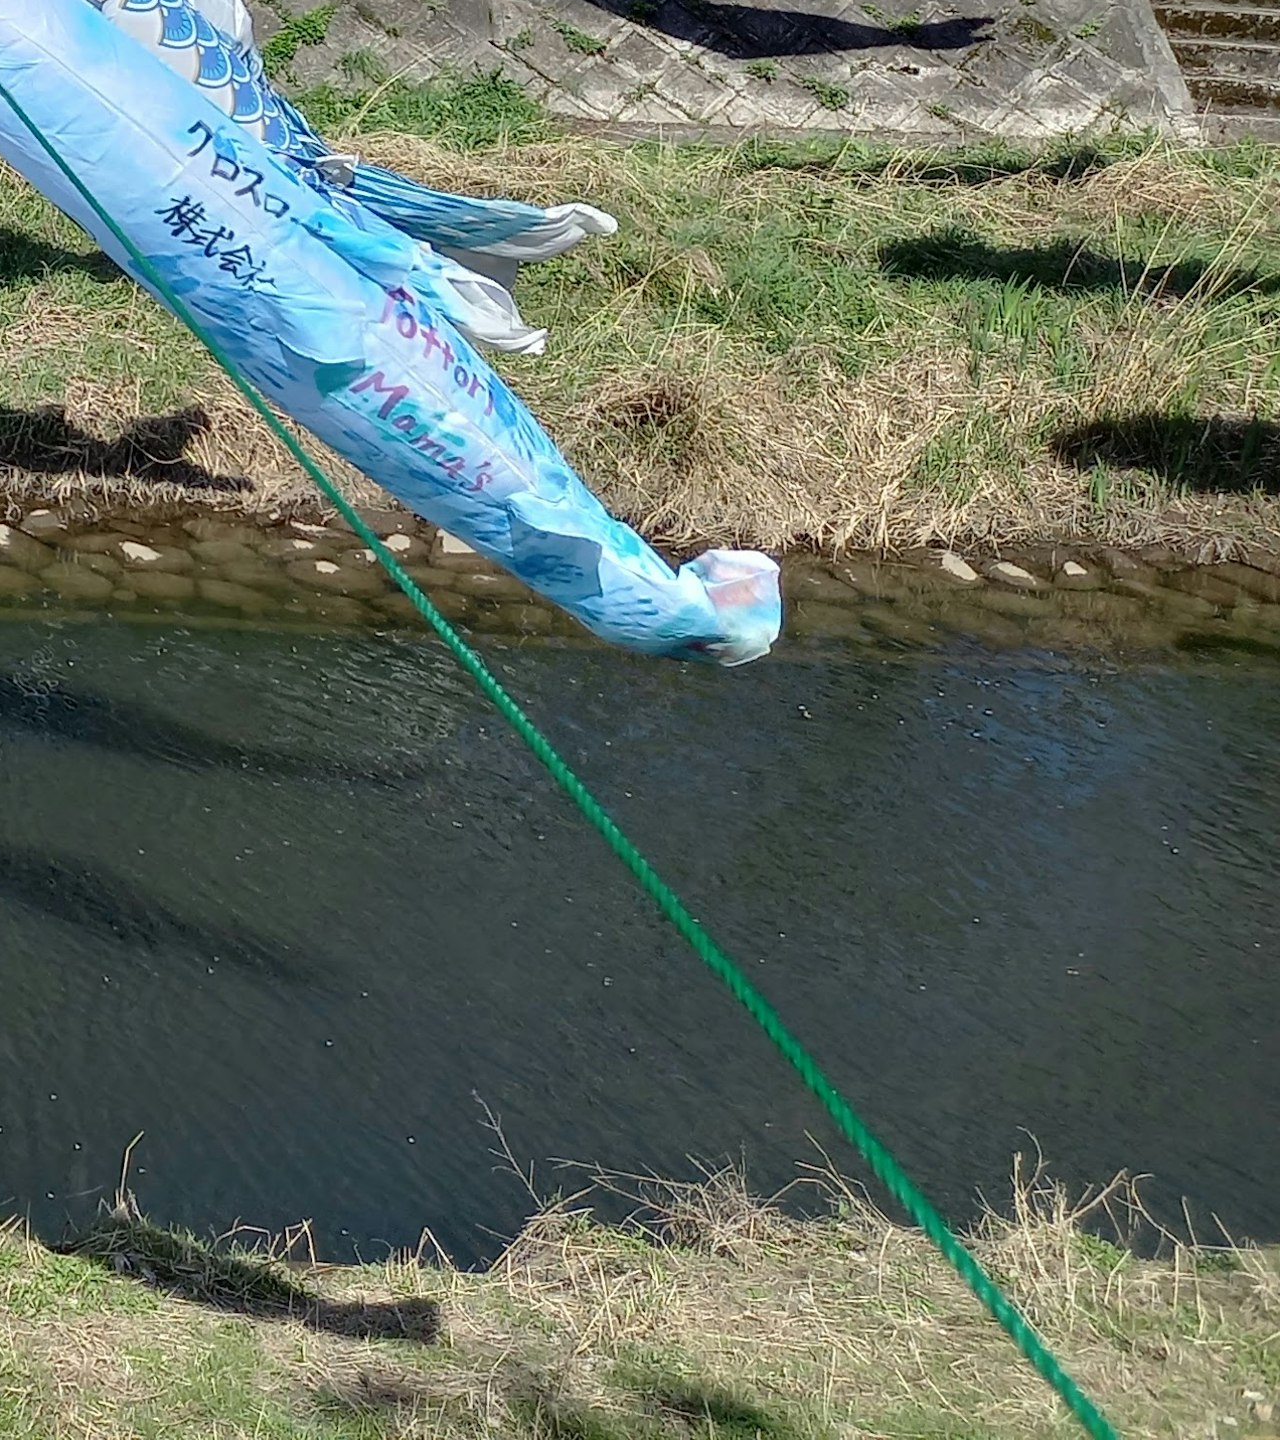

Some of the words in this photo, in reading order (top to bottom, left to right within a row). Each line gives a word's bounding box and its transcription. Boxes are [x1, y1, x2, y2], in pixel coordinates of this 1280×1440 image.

[154, 195, 278, 291] 株式会社
[349, 371, 493, 492] Mama's
